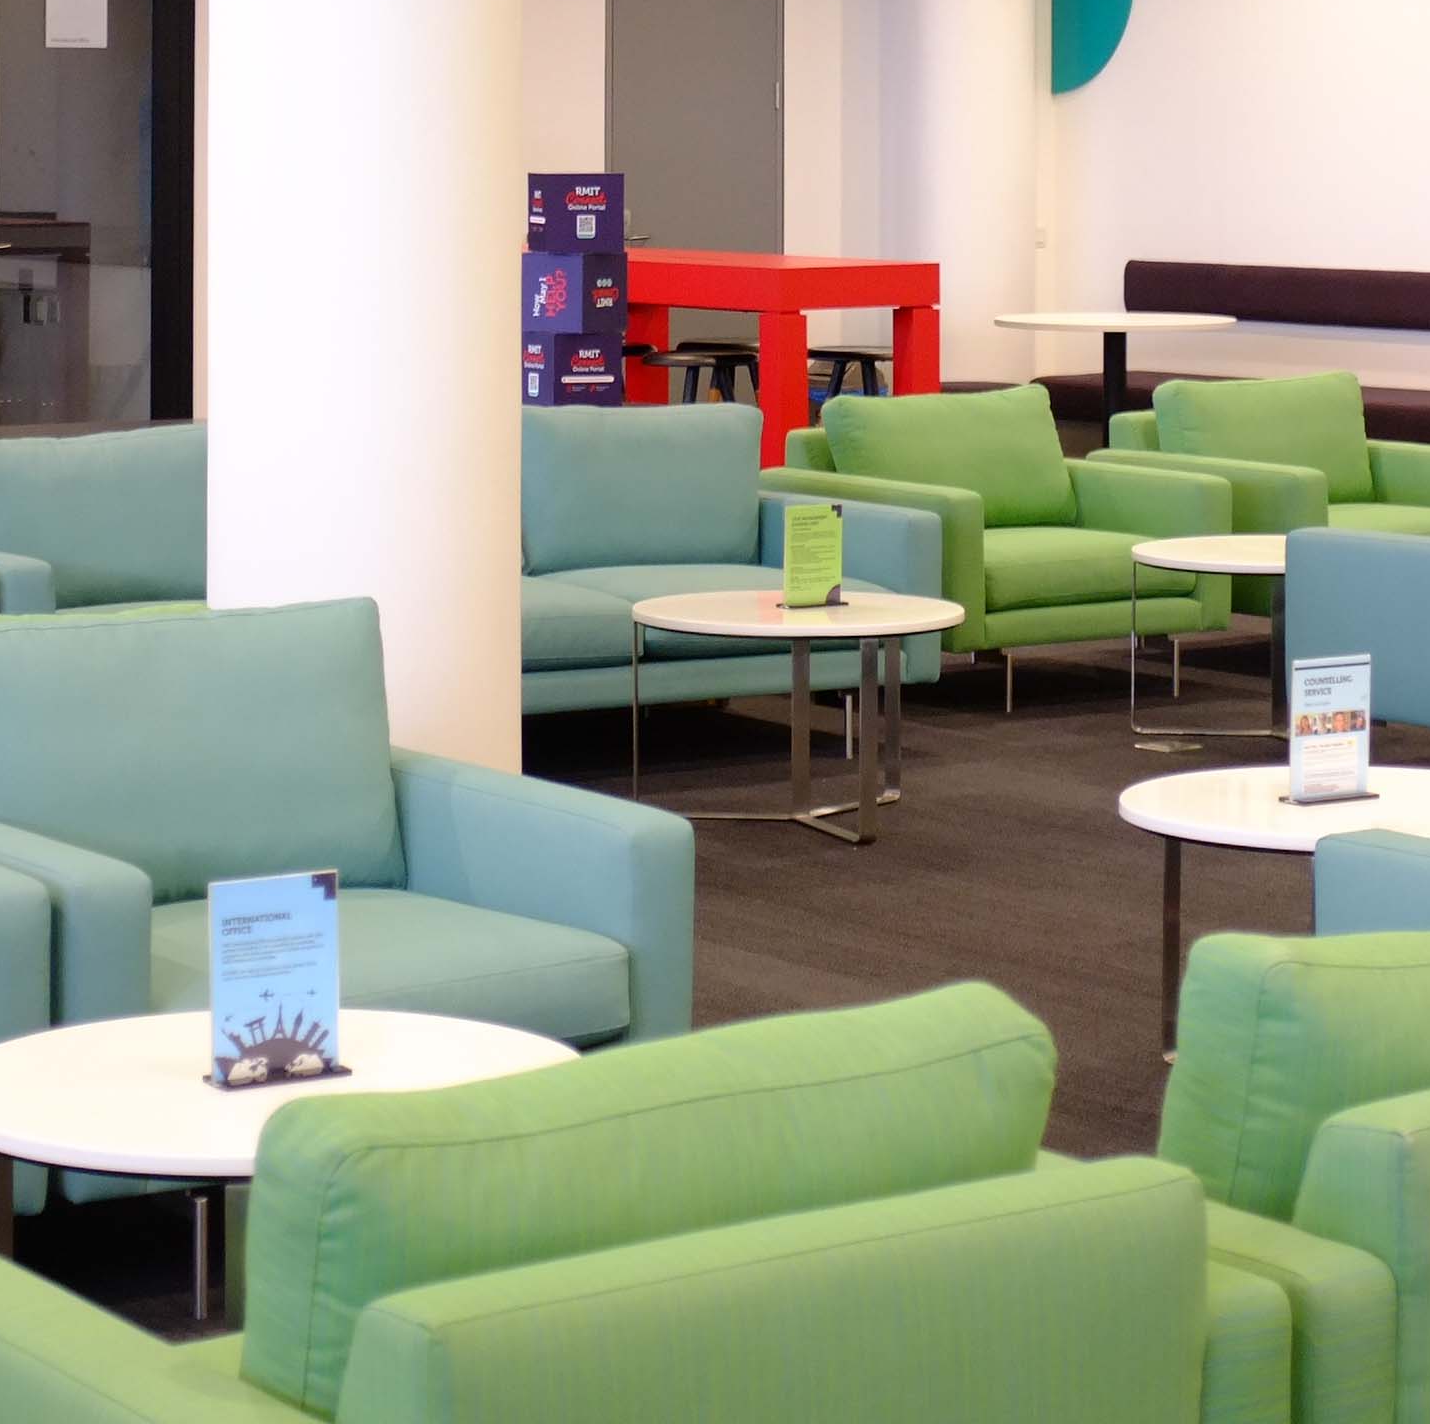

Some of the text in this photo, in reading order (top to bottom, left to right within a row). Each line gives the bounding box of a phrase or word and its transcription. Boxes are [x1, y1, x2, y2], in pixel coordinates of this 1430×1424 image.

[575, 186, 600, 196] RMIT
[579, 349, 600, 359] RMIT
[222, 912, 292, 926] INTERNATIONAL
[222, 926, 251, 936] OFFICE
